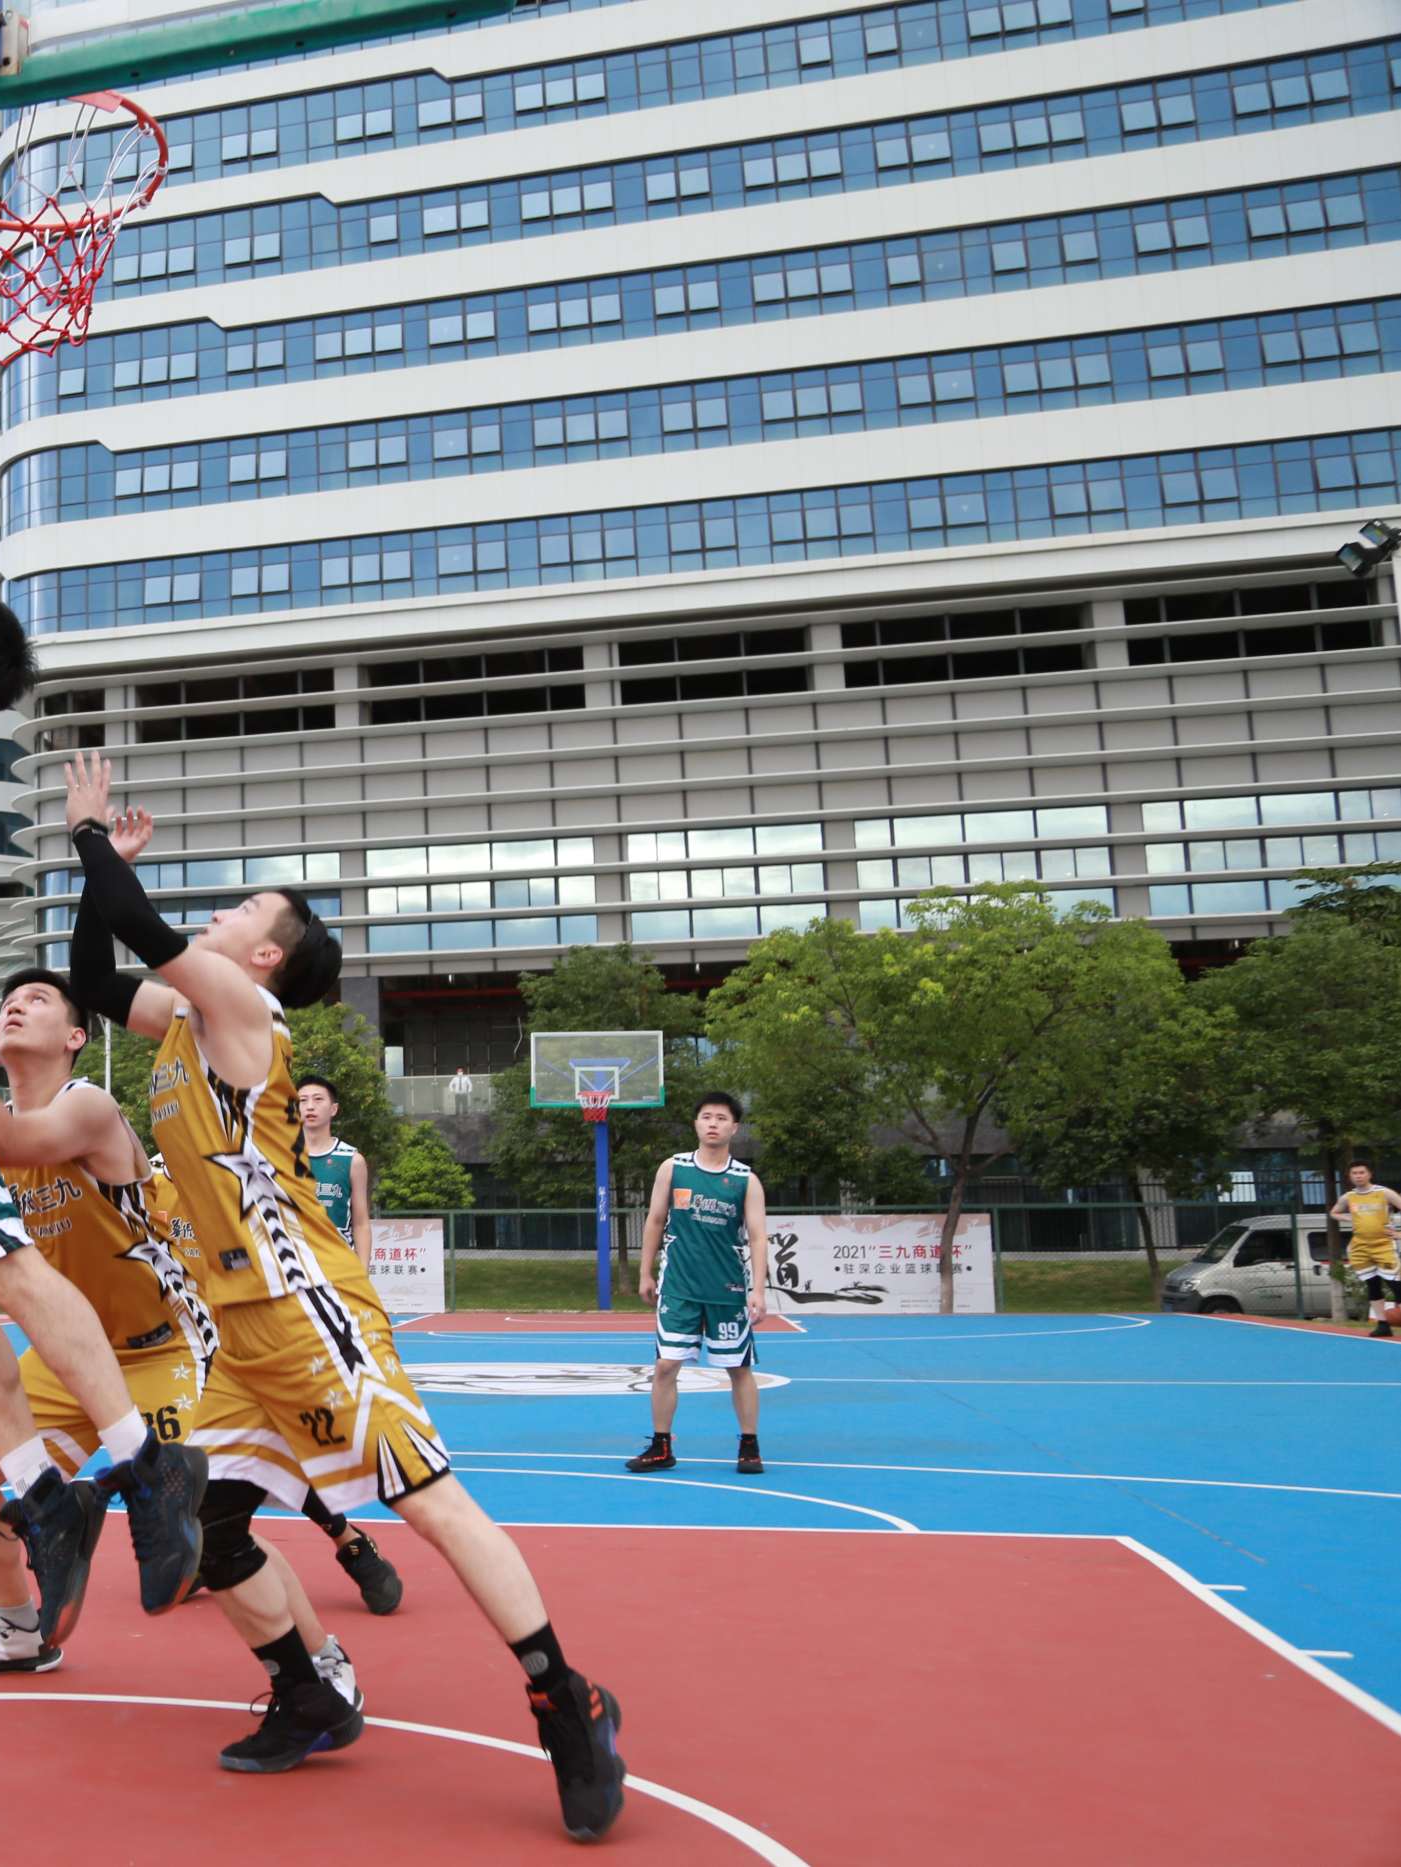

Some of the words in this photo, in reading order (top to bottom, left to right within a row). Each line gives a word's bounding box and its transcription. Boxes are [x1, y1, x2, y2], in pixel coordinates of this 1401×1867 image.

[374, 1247, 426, 1262] 商道杯”
[718, 1322, 740, 1340] 99
[300, 1407, 347, 1448] 22
